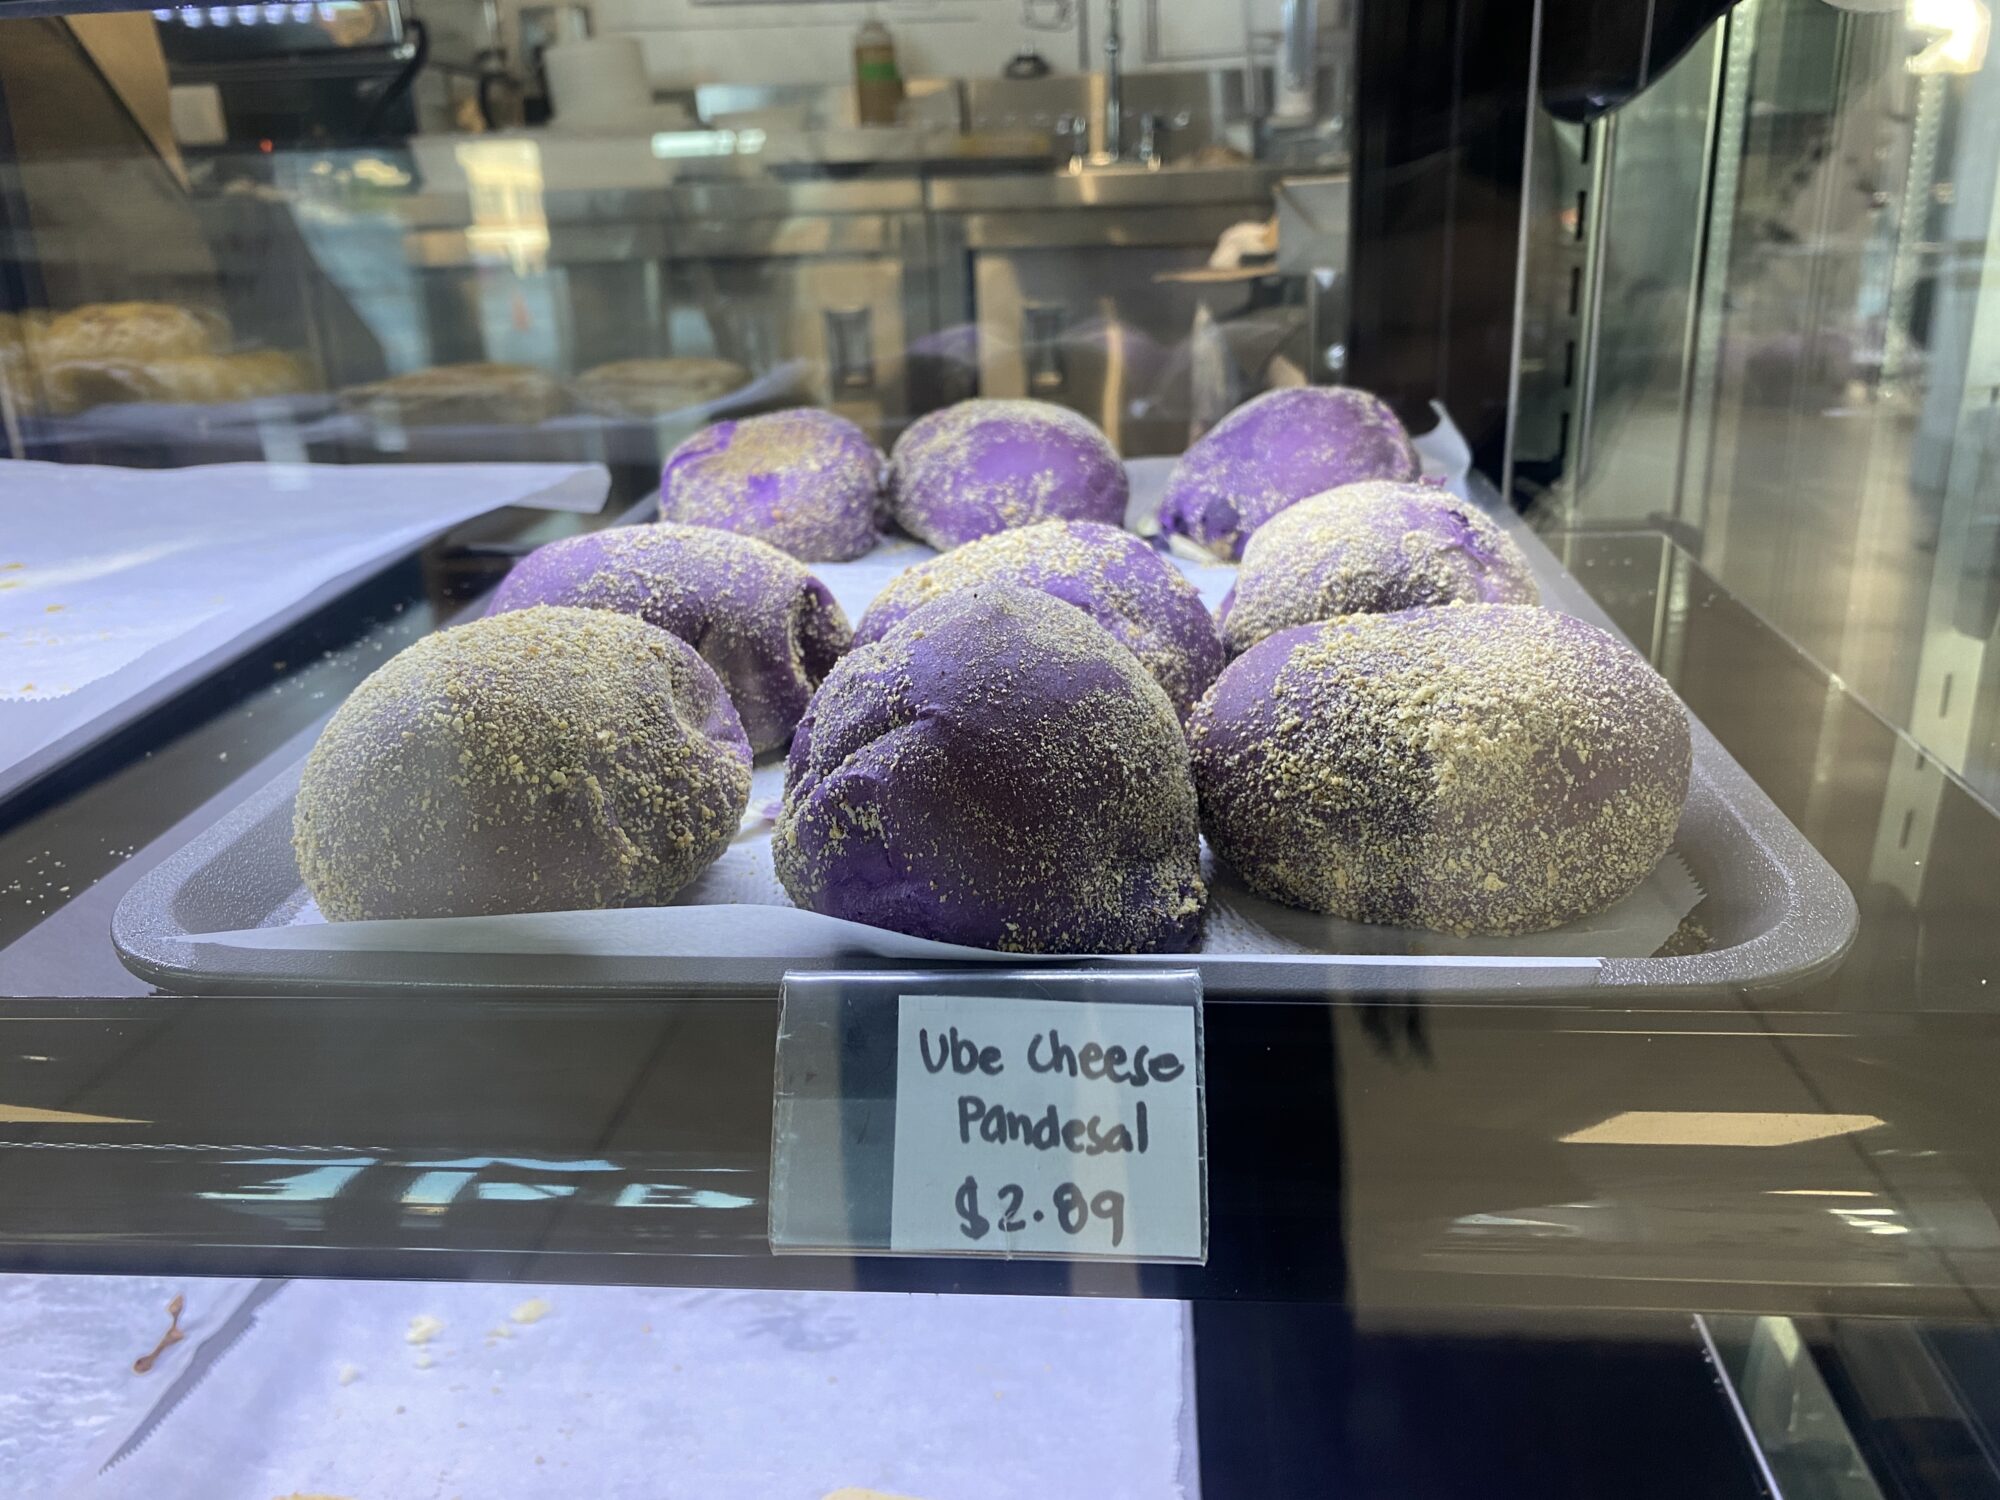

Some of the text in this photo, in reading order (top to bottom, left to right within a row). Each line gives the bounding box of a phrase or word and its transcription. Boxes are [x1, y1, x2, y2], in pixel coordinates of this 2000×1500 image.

[919, 1025, 1186, 1087] Ube Cheese
[957, 1095, 1149, 1156] Pandesal
[954, 1175, 1126, 1248] $2.89
